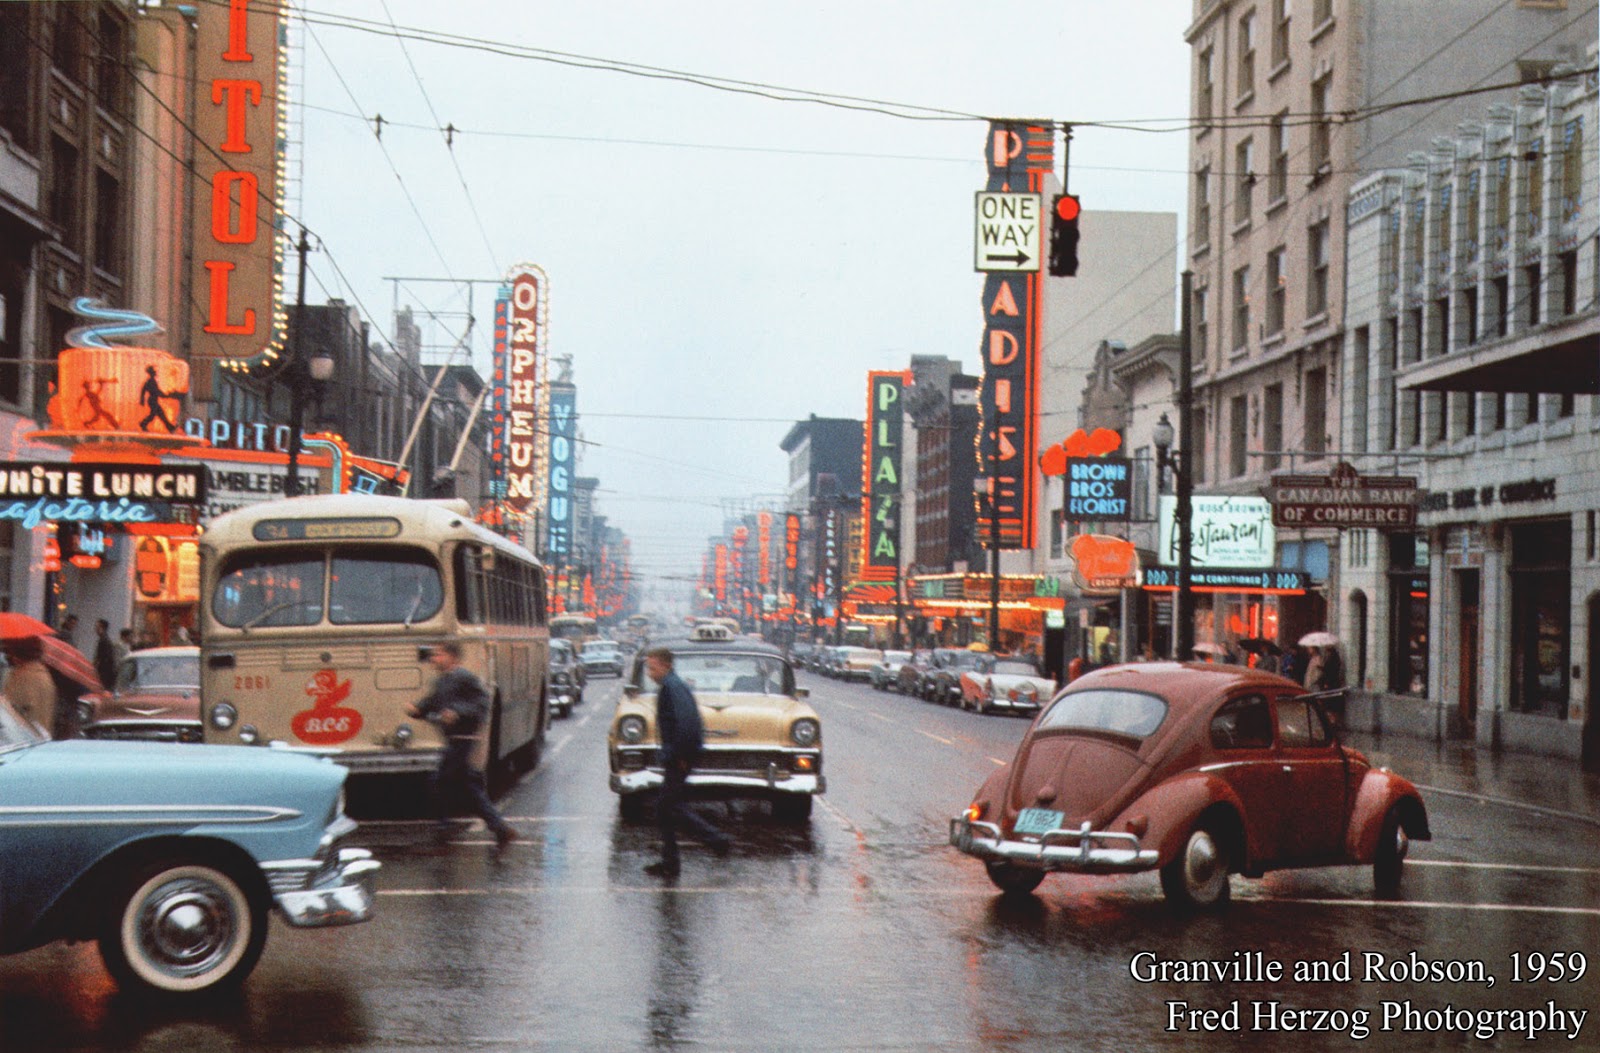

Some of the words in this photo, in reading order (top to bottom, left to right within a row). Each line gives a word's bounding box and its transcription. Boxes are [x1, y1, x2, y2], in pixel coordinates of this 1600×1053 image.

[982, 196, 1034, 220] ONE
[982, 224, 1034, 247] WAY
[988, 130, 1022, 512] PADISE
[507, 283, 537, 499] ORPHEUM
[550, 403, 571, 553] VOGUE
[874, 383, 897, 559] PLAZA
[1070, 463, 1127, 480] BROWN
[1331, 476, 1362, 488] THE
[93, 472, 196, 498] LUNCH
[1070, 481, 1115, 497] BROS
[1276, 488, 1362, 504] CANADIAN
[1370, 488, 1417, 504] BANK
[0, 497, 156, 529] afeteria
[1069, 498, 1127, 515] FLORIST
[1284, 507, 1306, 521] OF
[1314, 507, 1408, 521] COMMERCE
[698, 628, 728, 638] TAXI
